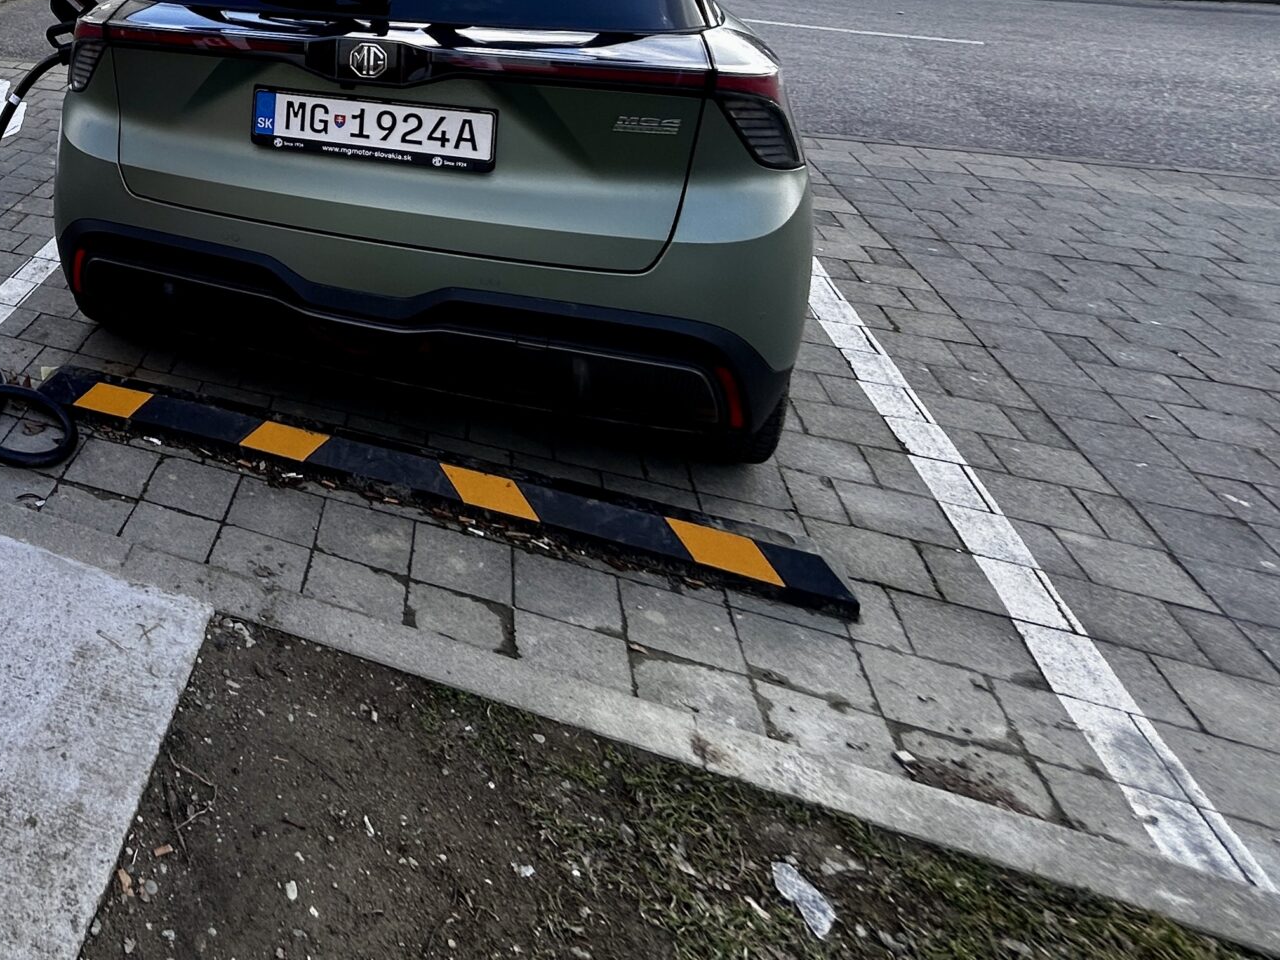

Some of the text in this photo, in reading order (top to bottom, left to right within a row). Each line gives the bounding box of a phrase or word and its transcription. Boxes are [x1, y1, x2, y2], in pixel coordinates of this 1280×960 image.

[350, 42, 387, 78] MG
[257, 117, 273, 129] SK
[285, 100, 478, 152] MG 1924A
[322, 144, 412, 161] www.mgmotor-slovakia.sk
